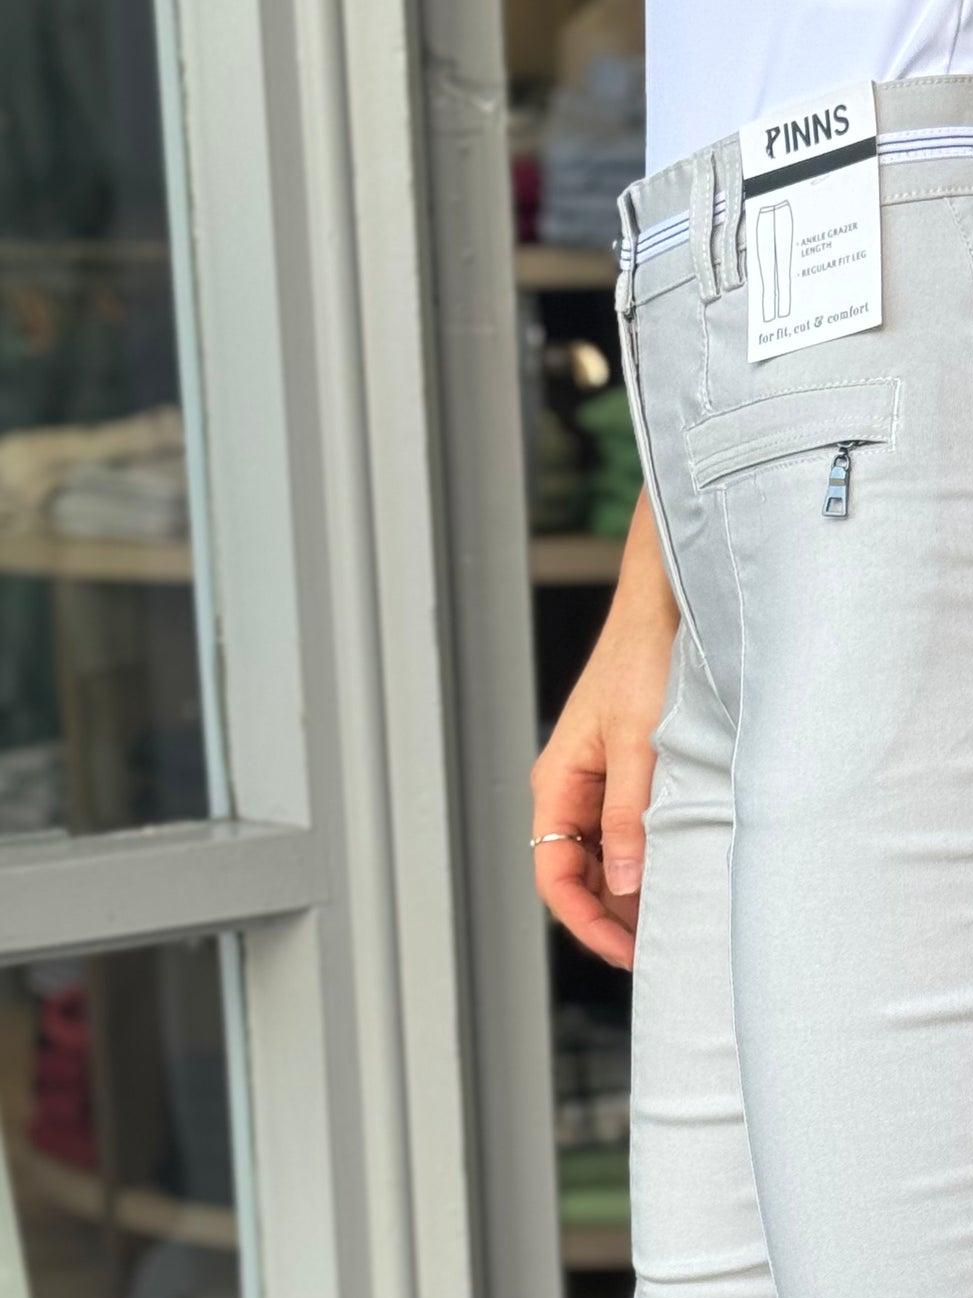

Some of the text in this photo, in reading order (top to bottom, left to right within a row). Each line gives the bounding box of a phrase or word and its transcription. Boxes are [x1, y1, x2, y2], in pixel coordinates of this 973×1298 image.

[765, 104, 850, 159] PINNS
[801, 221, 858, 247] ANKLE GRAZER
[801, 241, 832, 258] LENGTH
[802, 250, 867, 278] REGULAR FIT LEG
[758, 302, 869, 345] for fit, cut & comfort
